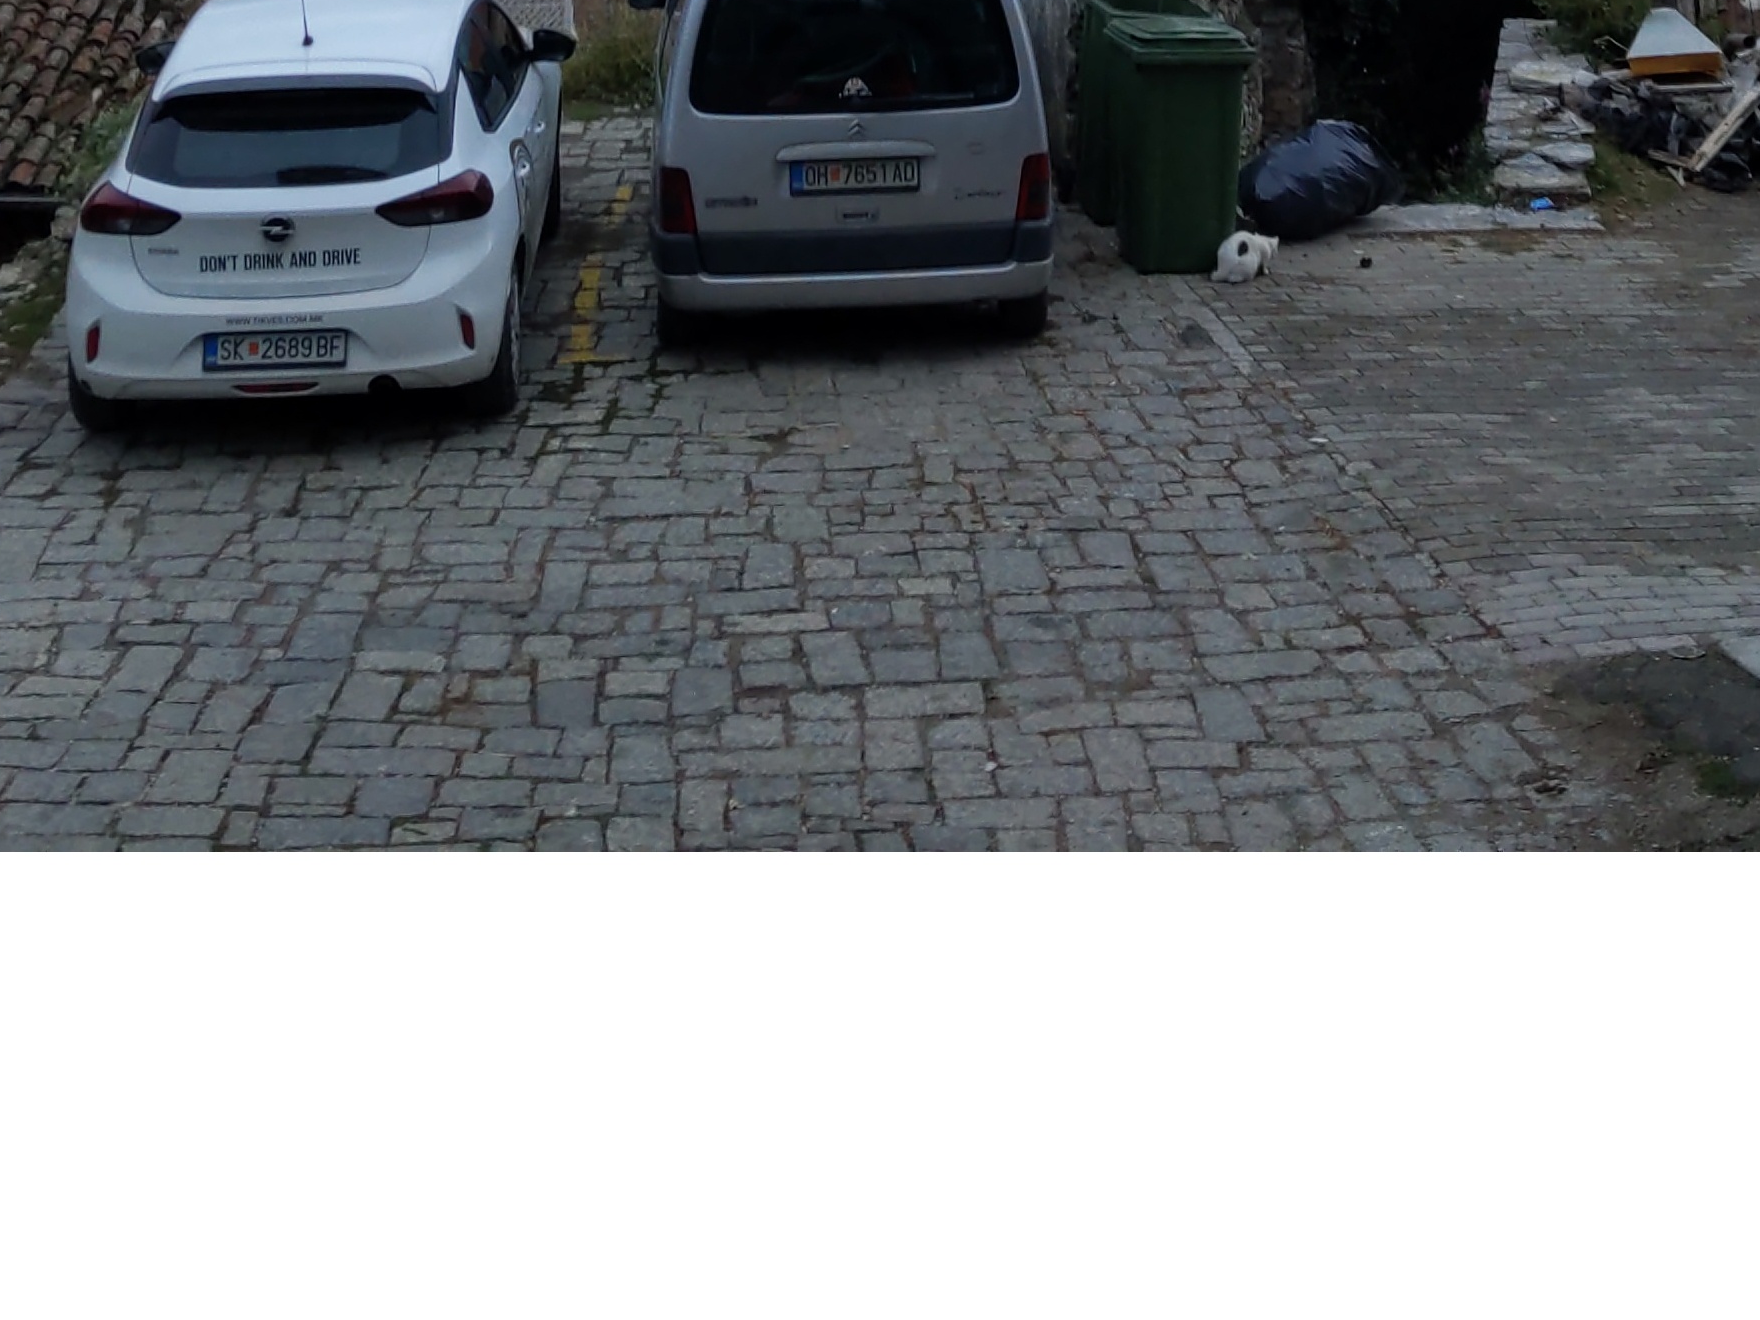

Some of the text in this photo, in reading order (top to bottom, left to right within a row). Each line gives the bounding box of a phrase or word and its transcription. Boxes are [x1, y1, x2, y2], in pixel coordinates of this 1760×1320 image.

[199, 247, 361, 273] DON'T DRINK AND DRIVE
[220, 334, 342, 361] SK 2689 BF
